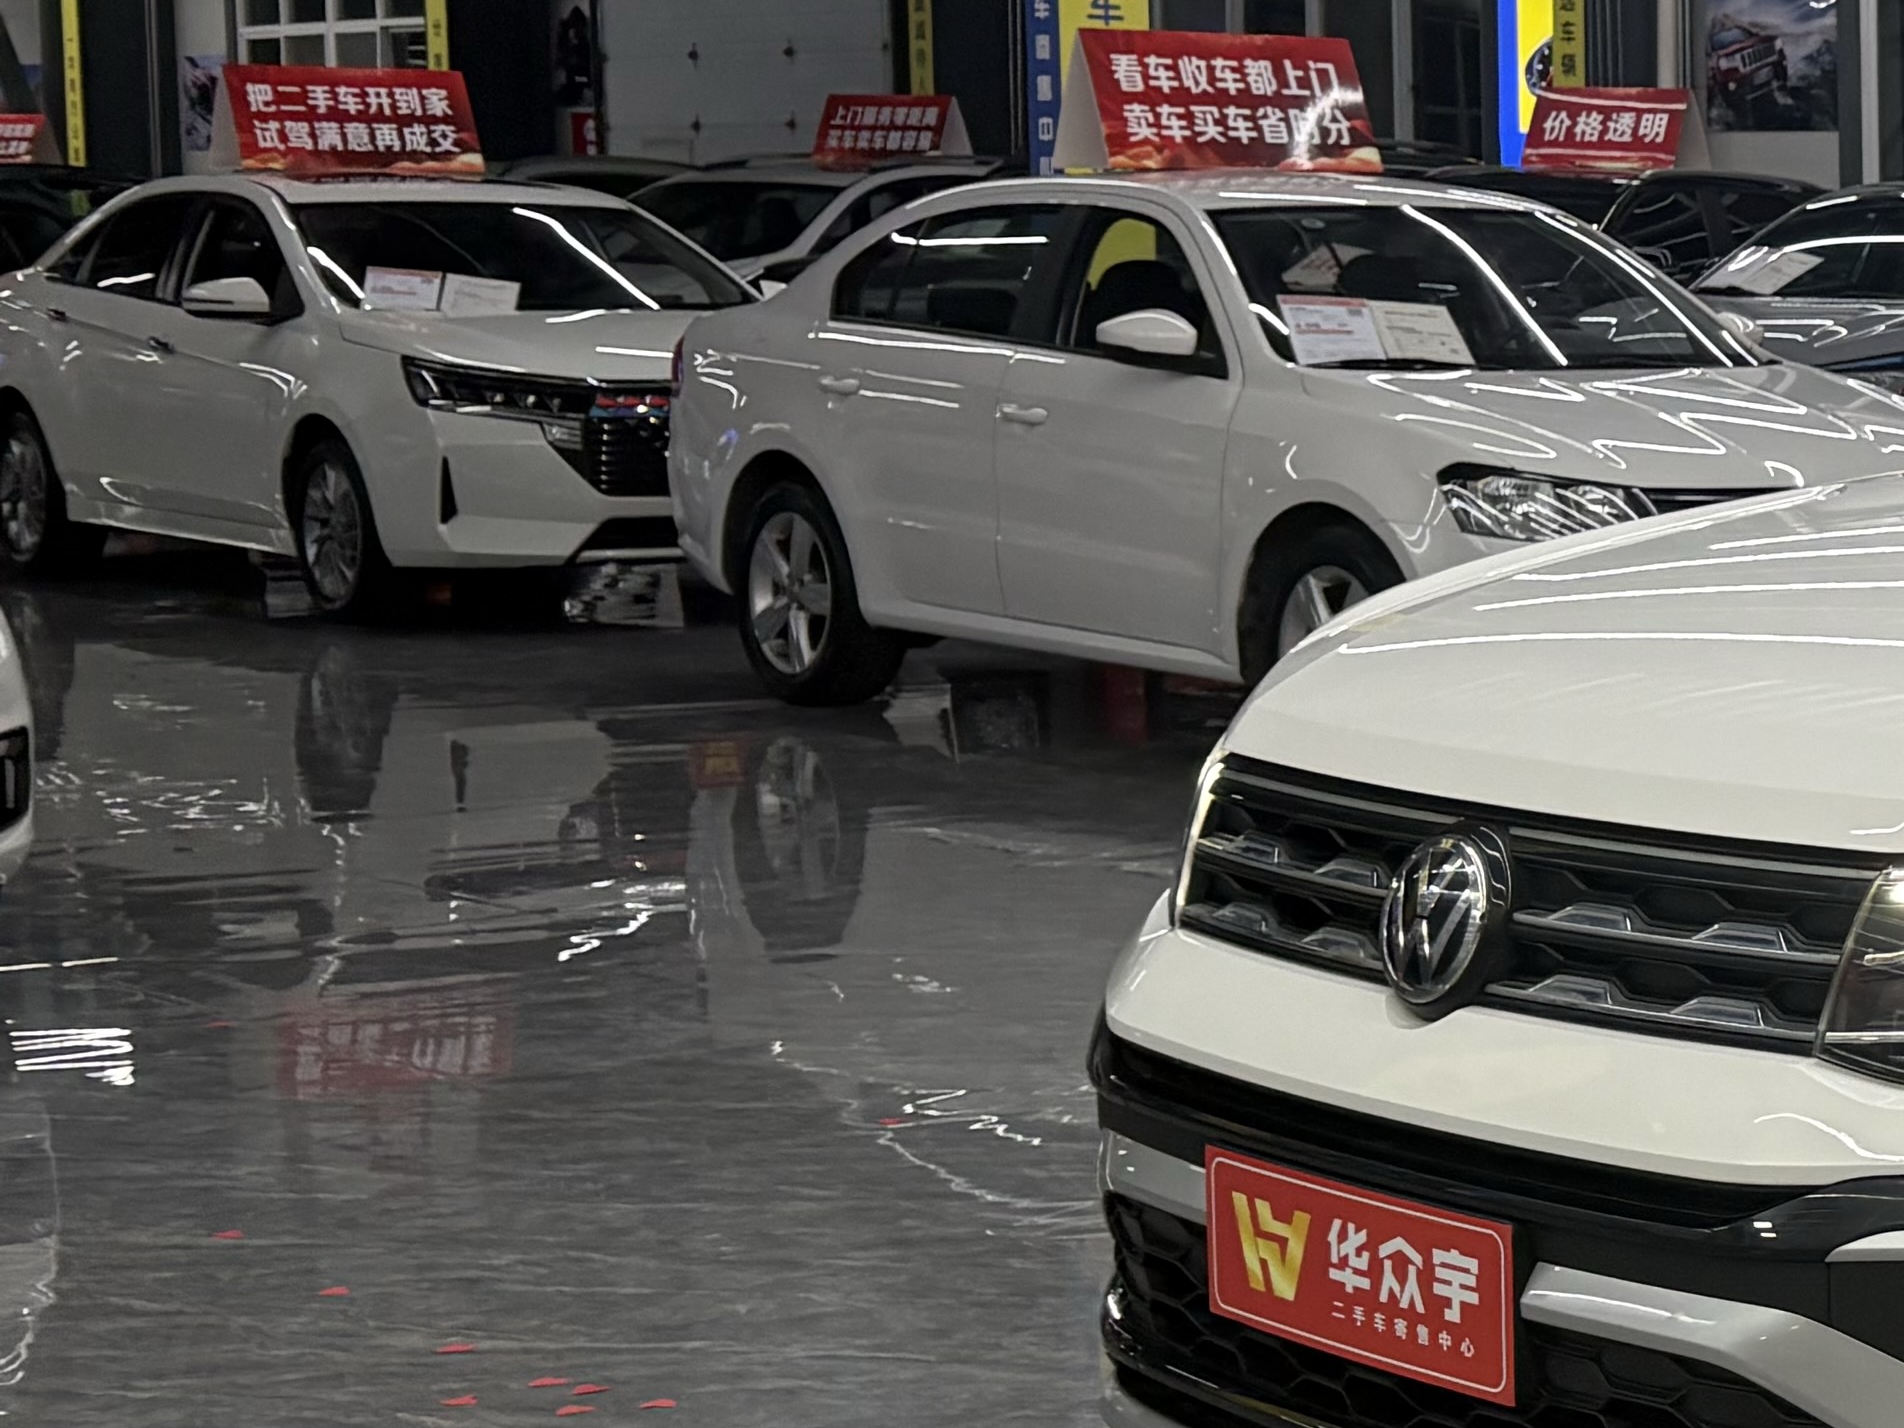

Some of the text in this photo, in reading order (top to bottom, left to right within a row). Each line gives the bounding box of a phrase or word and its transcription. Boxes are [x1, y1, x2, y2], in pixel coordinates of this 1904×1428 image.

[1108, 52, 1340, 98] 看车收车都上门
[245, 81, 454, 117] 把二手车开到家
[252, 120, 462, 154] 试驾满意再成交
[1541, 109, 1670, 144] 价格透明
[1326, 1217, 1480, 1324] 华众宇
